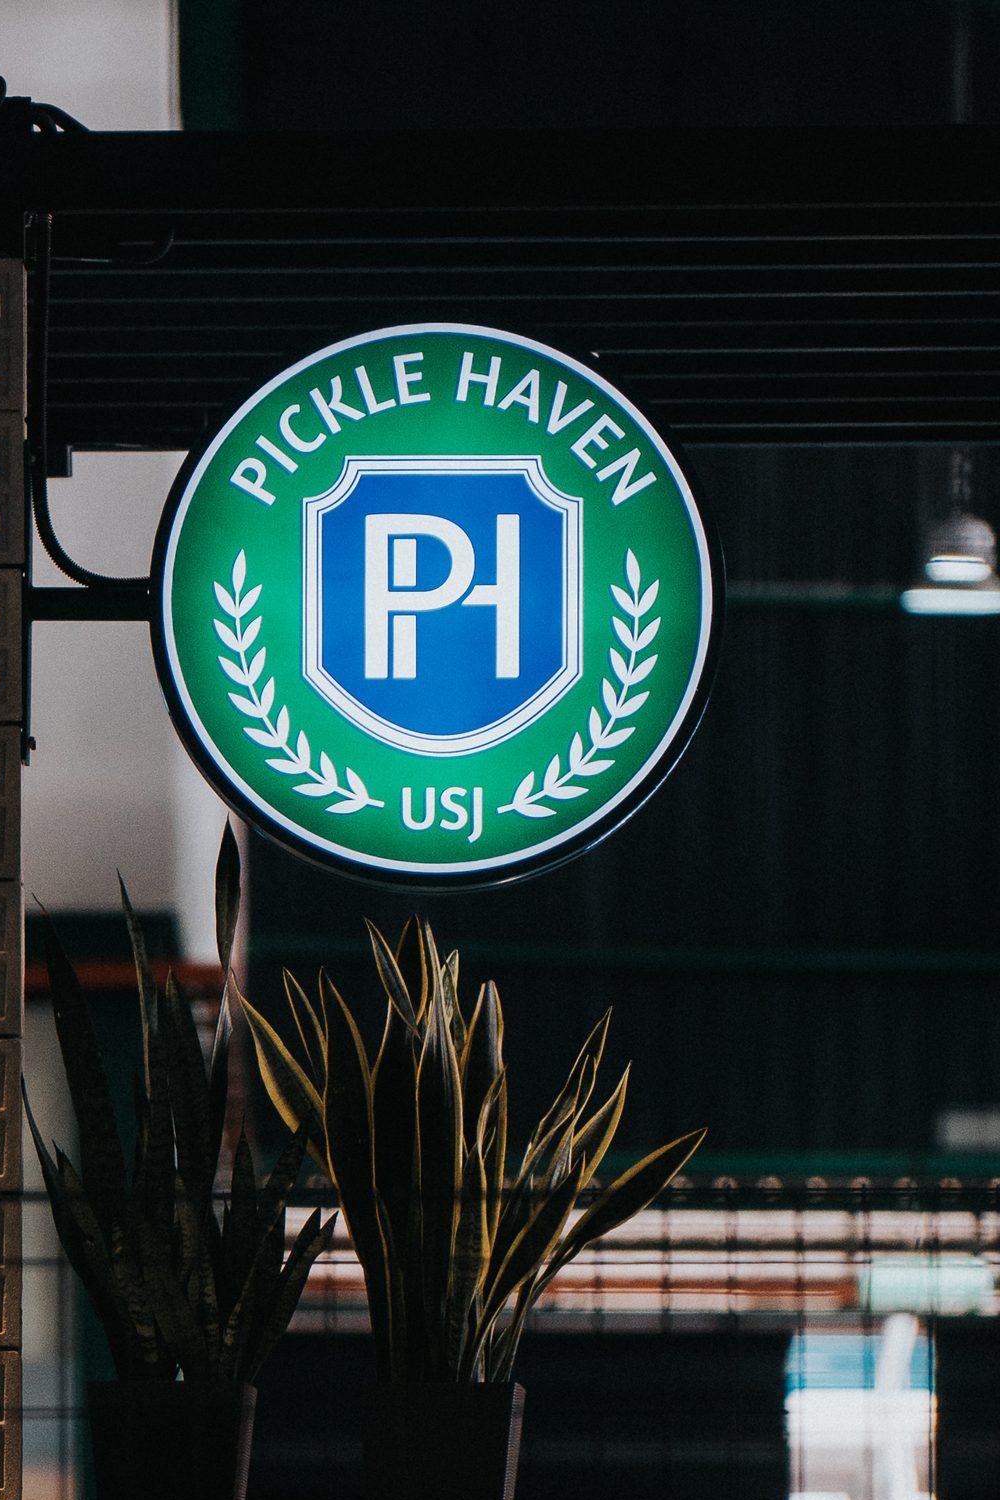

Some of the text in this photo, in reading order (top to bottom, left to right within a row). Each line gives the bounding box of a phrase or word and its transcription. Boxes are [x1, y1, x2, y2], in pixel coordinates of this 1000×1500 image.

[230, 352, 657, 506] PICKLE HAVEN
[365, 514, 520, 679] PH
[402, 787, 483, 843] USJ
